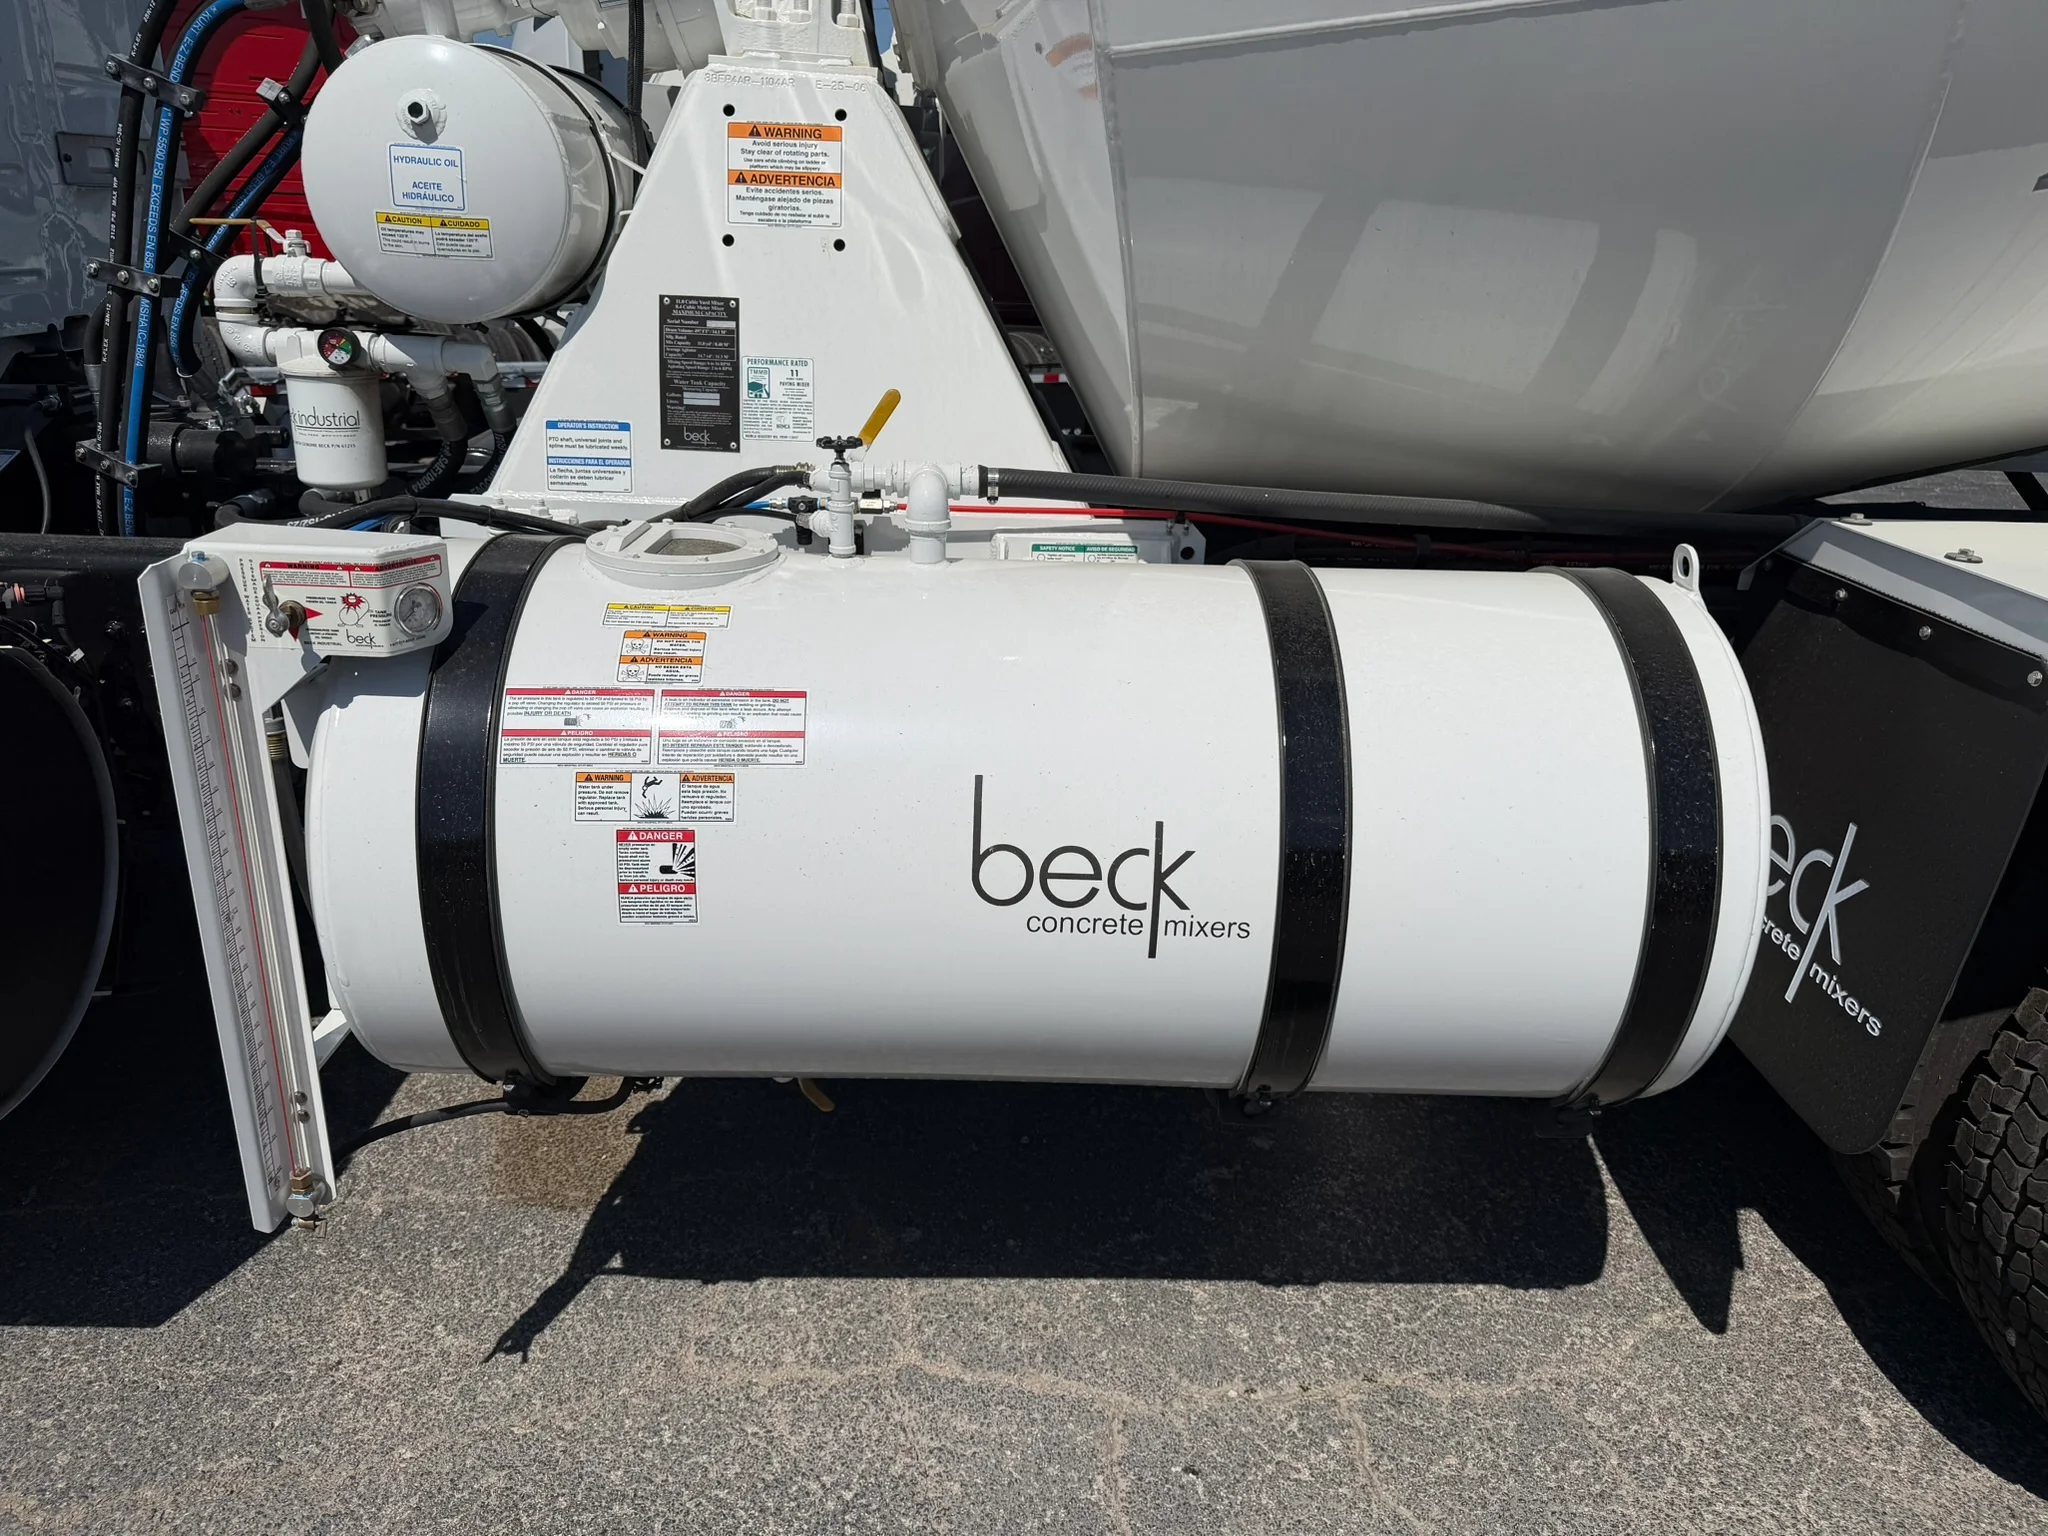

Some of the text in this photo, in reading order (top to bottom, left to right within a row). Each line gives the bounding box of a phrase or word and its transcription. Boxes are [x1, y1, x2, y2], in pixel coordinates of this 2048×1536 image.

[131, 32, 142, 57] K-FLEX
[170, 10, 213, 83] KURT E-Z BEND
[160, 117, 171, 136] WP
[764, 127, 822, 138] WARNING
[156, 137, 168, 159] 5500
[783, 150, 808, 158] rotating
[393, 156, 442, 166] HYDRAULIC
[153, 162, 164, 180] PSI
[750, 174, 835, 186] ADVERTENCIA
[412, 181, 442, 191] ACEITE
[402, 191, 454, 203] HIDRÁULICO
[736, 194, 775, 202] Manténgase
[148, 183, 161, 233] EXCEEDS
[392, 215, 422, 224] CAUTION
[146, 235, 156, 249] EN
[145, 251, 154, 269] 856
[172, 316, 180, 330] EN
[136, 298, 150, 367] MSHA IC-188/4
[298, 406, 360, 427] industrial
[684, 426, 710, 446] beck
[346, 629, 376, 649] beck
[640, 832, 683, 840] DANGER
[972, 774, 1196, 959] beck
[1767, 814, 1870, 1003] eck
[1026, 914, 1251, 939] concrete mixers
[1809, 962, 1883, 1037] mixers
